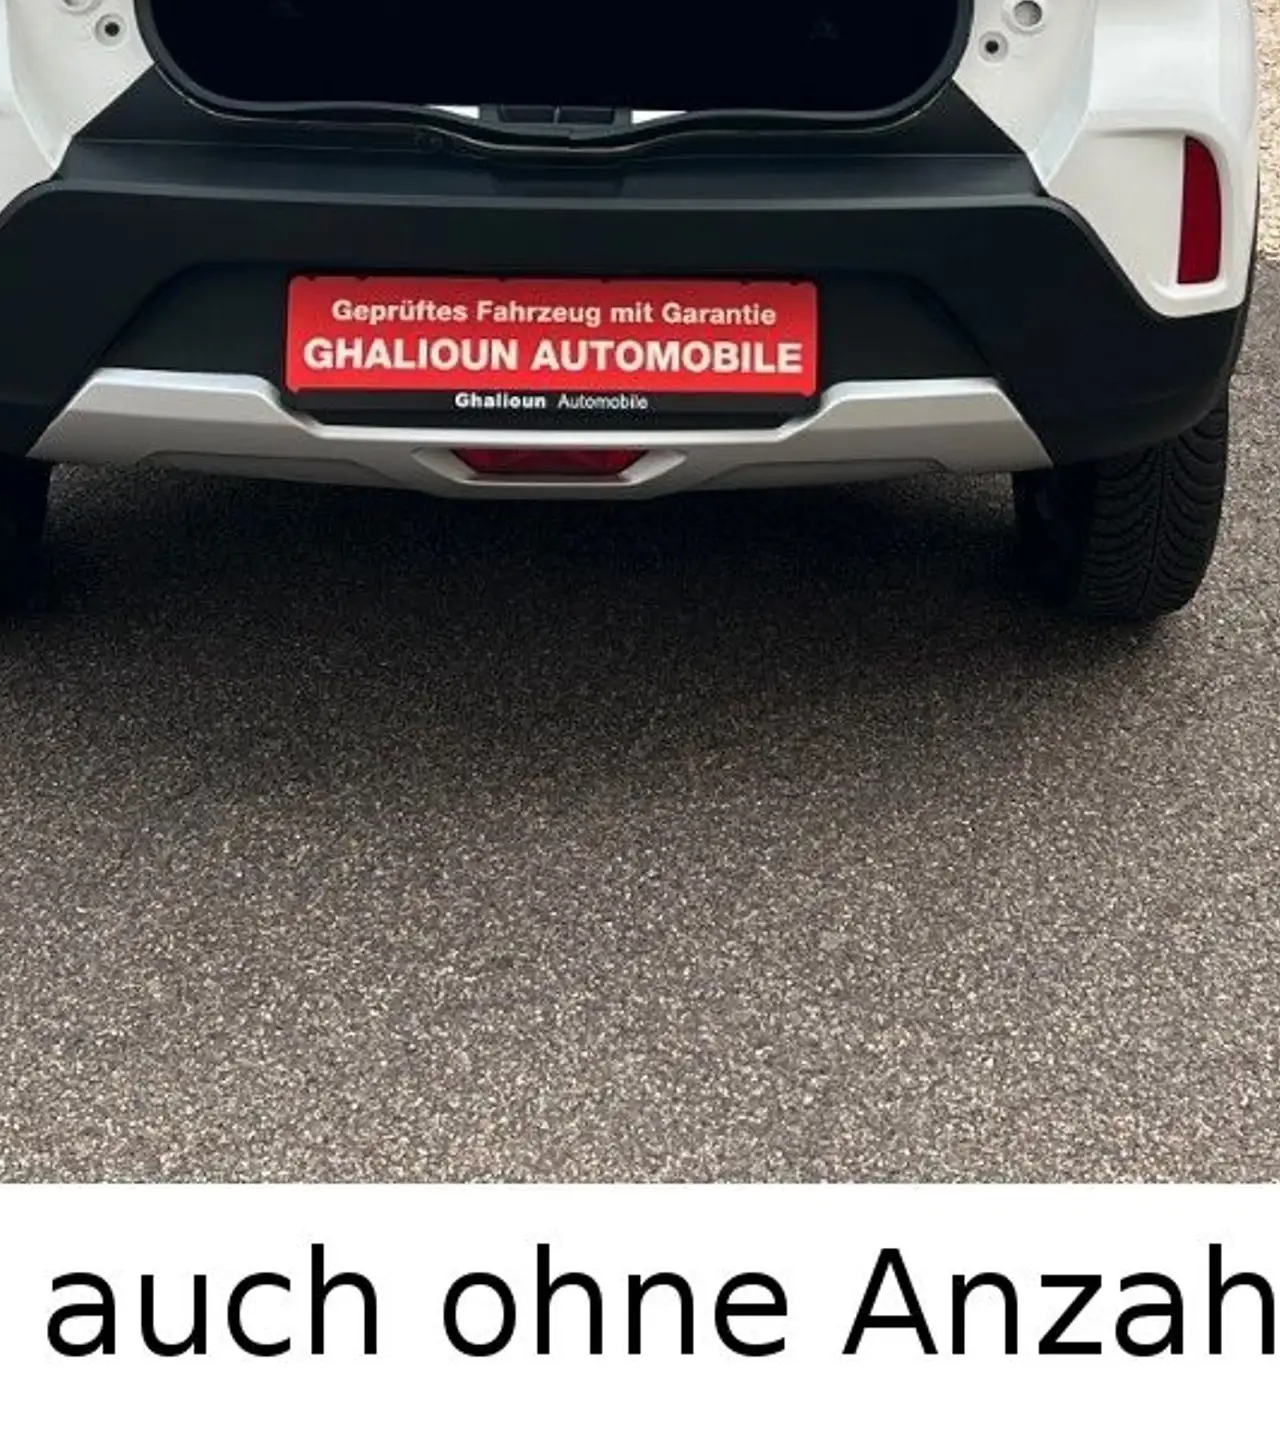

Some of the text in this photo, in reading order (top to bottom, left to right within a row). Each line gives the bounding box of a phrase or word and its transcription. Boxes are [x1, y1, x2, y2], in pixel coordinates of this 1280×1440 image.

[332, 299, 777, 328] Geprüftes Fahrzeug mit Garantie
[303, 337, 804, 374] GHALIOUN AUTOMOBILE
[454, 392, 649, 410] Ghalioun Automobile
